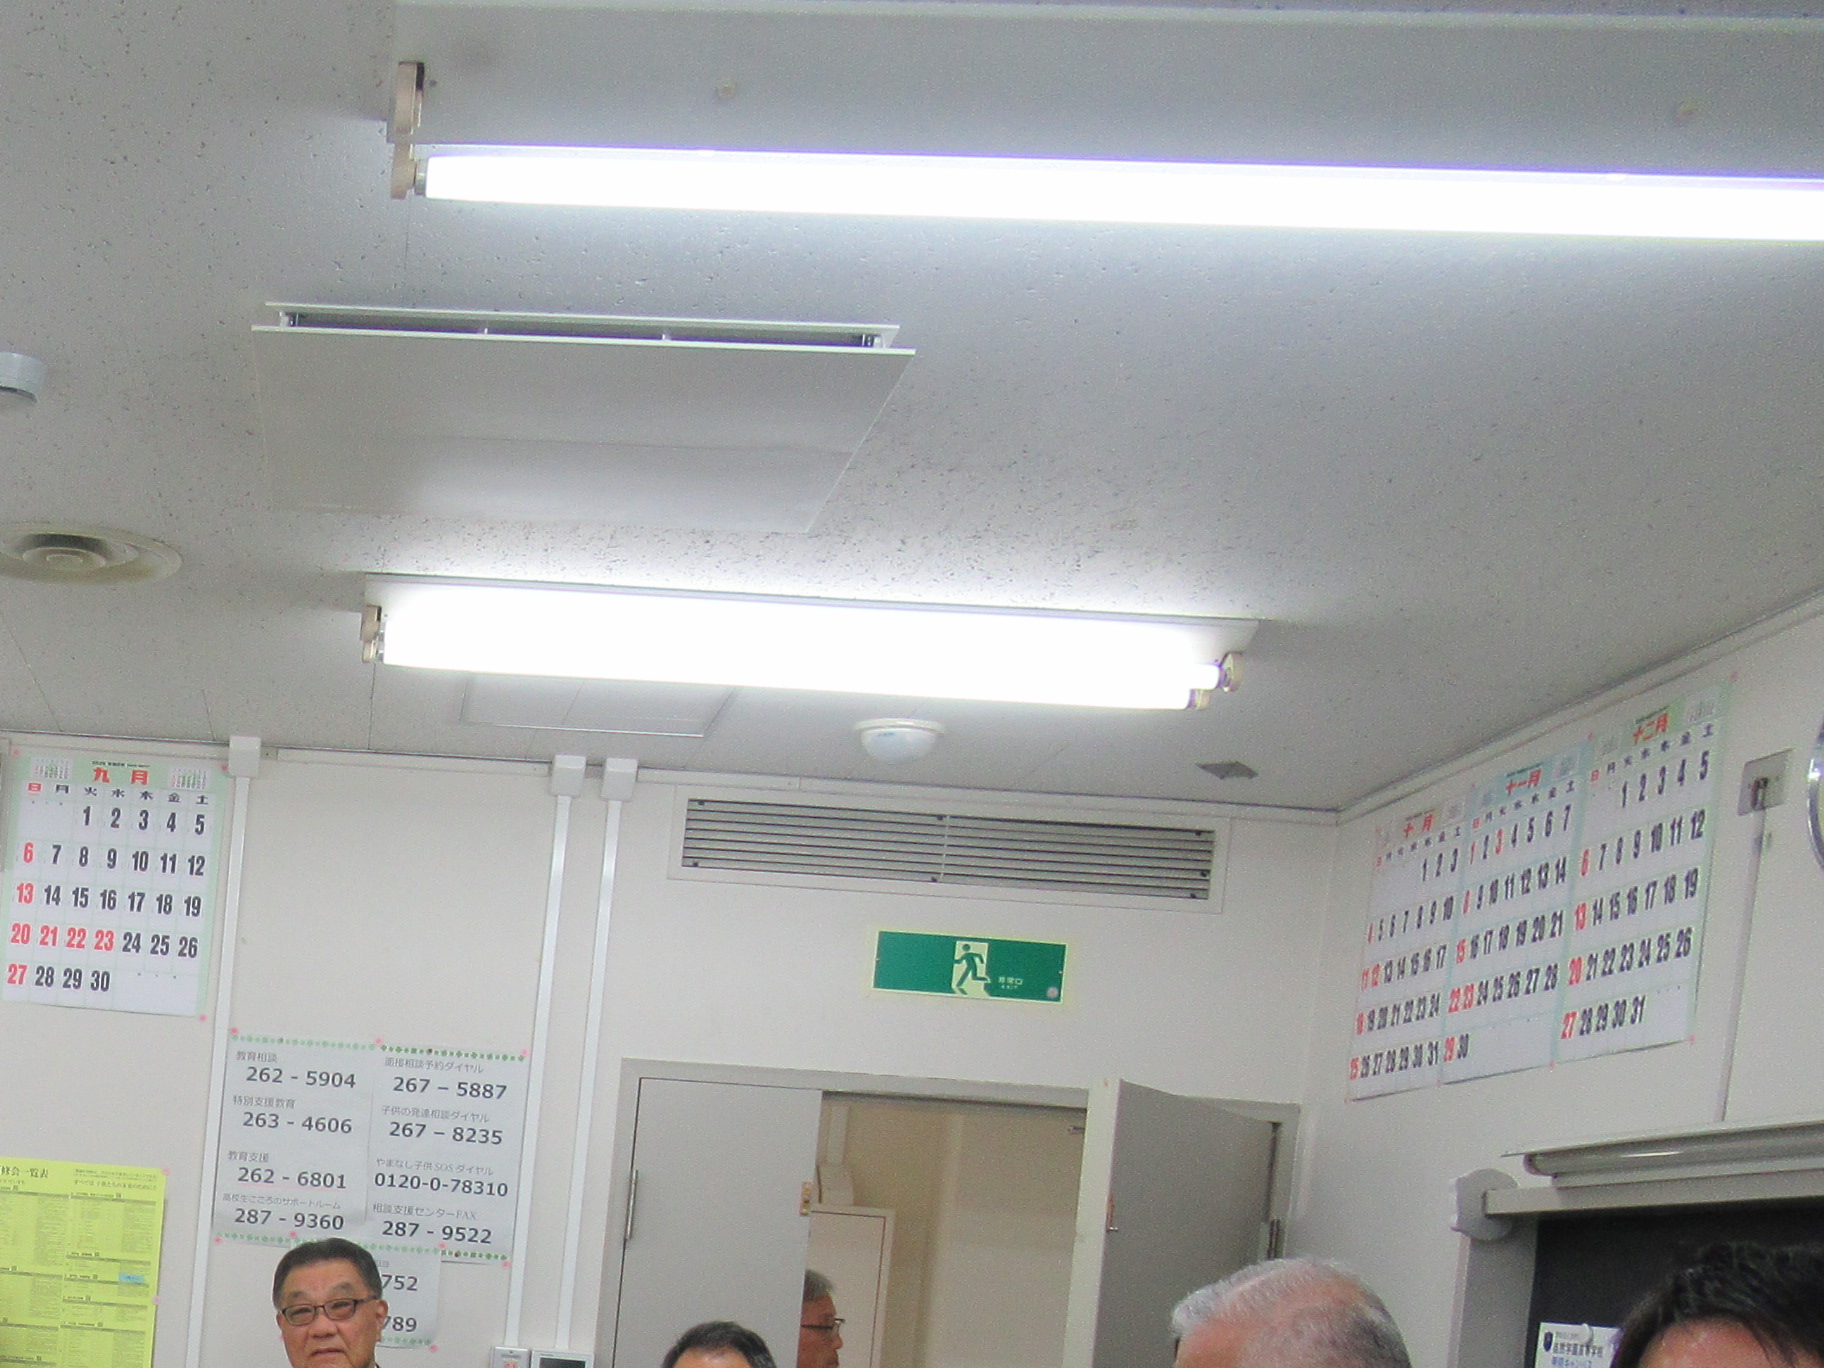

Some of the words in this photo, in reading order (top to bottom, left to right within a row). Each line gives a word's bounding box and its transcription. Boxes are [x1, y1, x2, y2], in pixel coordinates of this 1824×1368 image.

[1574, 902, 1587, 931] 13
[1592, 897, 1604, 926] 14
[1609, 891, 1621, 921] 15
[1626, 885, 1639, 916] 16
[1644, 880, 1658, 911] 17
[1663, 874, 1677, 905] 18
[1684, 867, 1699, 900] 19
[10, 922, 31, 945] 20
[39, 924, 58, 947] 21
[65, 927, 87, 949] 22
[93, 929, 115, 952] 23
[121, 931, 142, 954] 24
[149, 934, 170, 956] 25
[177, 936, 198, 959] 26
[1476, 979, 1489, 1007] 24
[1492, 975, 1505, 1003] 25
[1507, 970, 1521, 999] 26
[1524, 967, 1541, 995] 27
[1543, 962, 1558, 992] 28
[236, 1051, 277, 1063] 教育相談
[384, 1057, 484, 1074] 面接相談予約ダイヤル
[246, 1066, 283, 1083] 262
[305, 1070, 356, 1088] 5904
[393, 1076, 430, 1093] 267
[456, 1082, 507, 1100] 5887
[232, 1095, 296, 1109] 特別支援教育
[242, 1111, 279, 1128] 263
[301, 1116, 352, 1134] 4606
[381, 1105, 490, 1123] 子供の発達相談ダイヤル
[389, 1121, 427, 1138] 267
[452, 1127, 503, 1145] 8235
[228, 1151, 269, 1163] 教育支援
[237, 1167, 274, 1184] 262
[297, 1171, 346, 1189] 6801
[374, 1172, 508, 1197] 0120-0-78310
[234, 1208, 272, 1225] 287
[294, 1212, 344, 1230] 9360
[382, 1220, 419, 1237] 287
[441, 1225, 492, 1244] 9522
[381, 1274, 418, 1291] 752
[383, 1316, 417, 1332] 789
